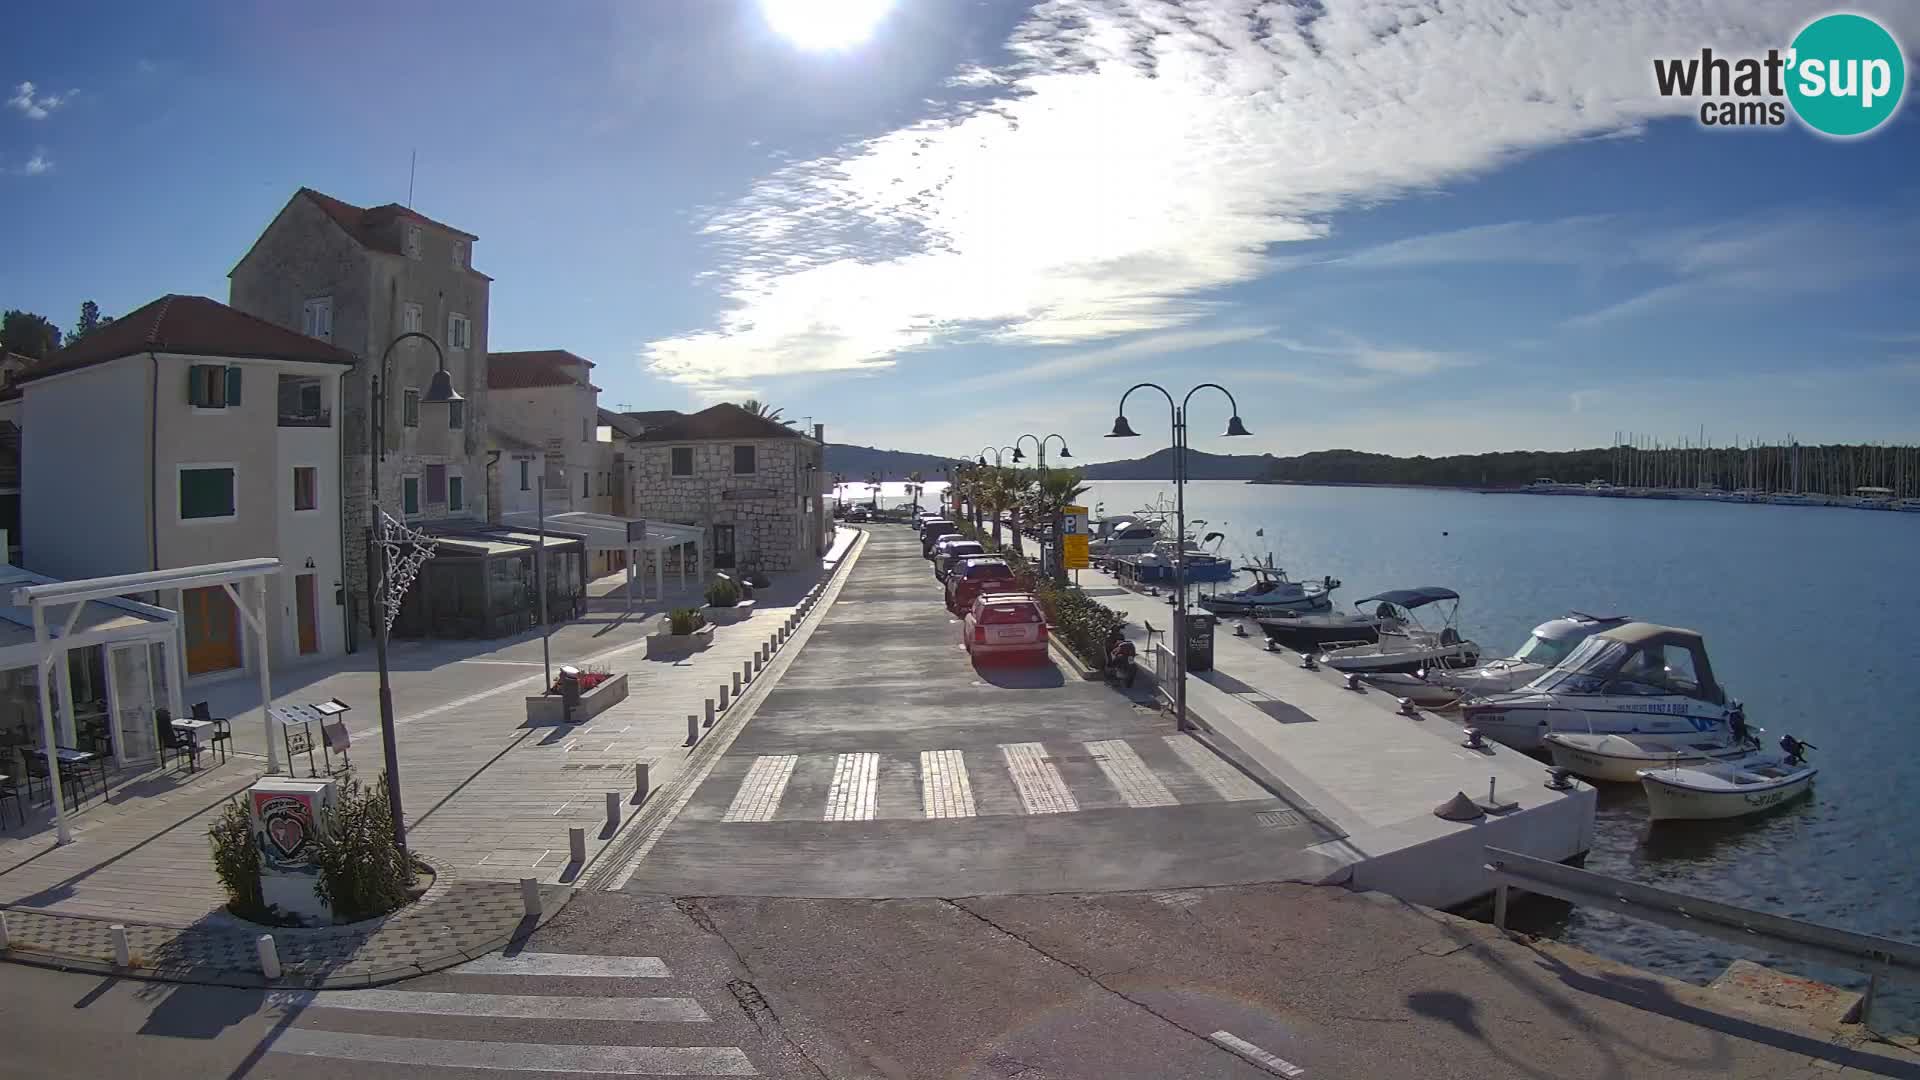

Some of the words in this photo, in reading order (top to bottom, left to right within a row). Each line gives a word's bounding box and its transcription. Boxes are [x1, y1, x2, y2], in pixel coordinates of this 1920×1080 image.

[1065, 516, 1076, 533] P
[1666, 703, 1671, 713] A
[1672, 703, 1689, 714] BOAT
